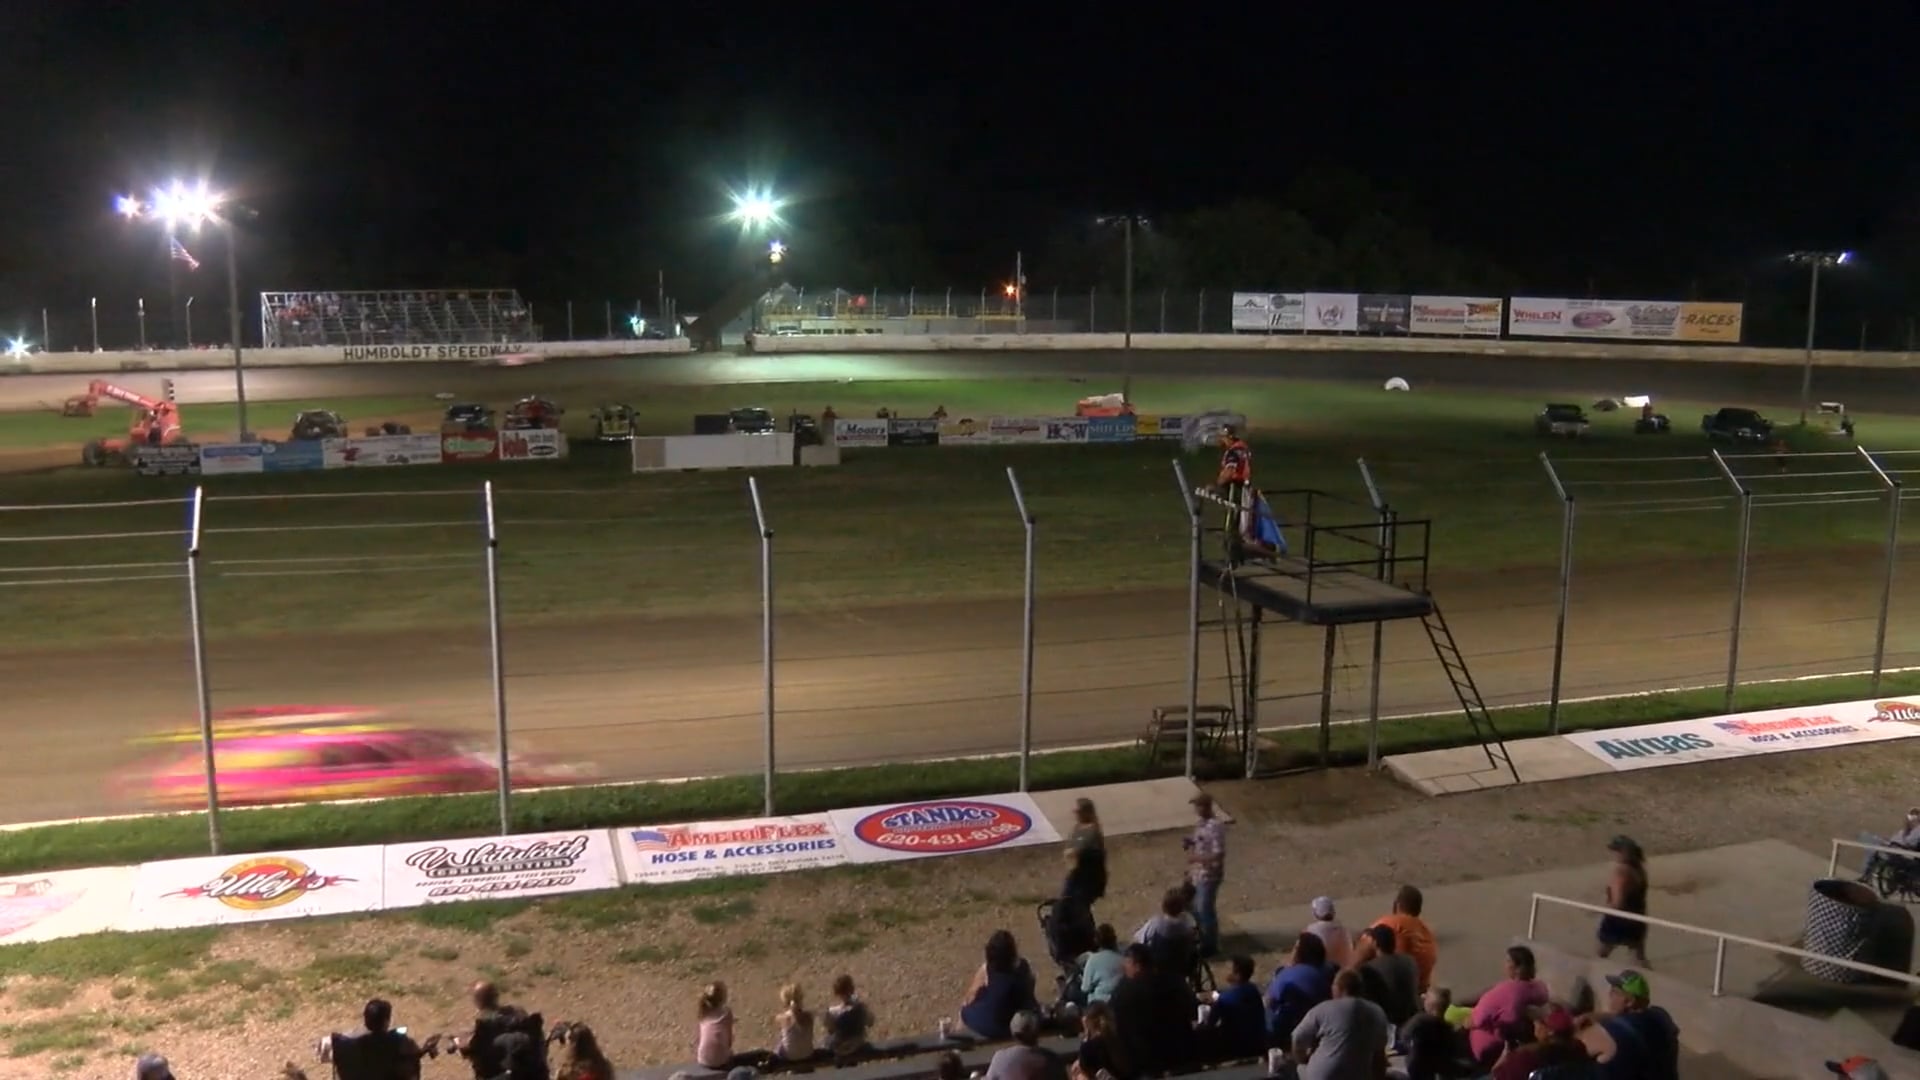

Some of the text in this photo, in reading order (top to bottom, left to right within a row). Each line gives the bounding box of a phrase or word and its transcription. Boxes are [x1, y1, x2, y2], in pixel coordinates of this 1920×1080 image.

[343, 345, 522, 361] HUMBOLDT SPEEDWAY
[1595, 732, 1715, 760] Airgas
[652, 838, 836, 864] HOSE & ACCESSORIES
[434, 860, 566, 877] CONSTRUCTION
